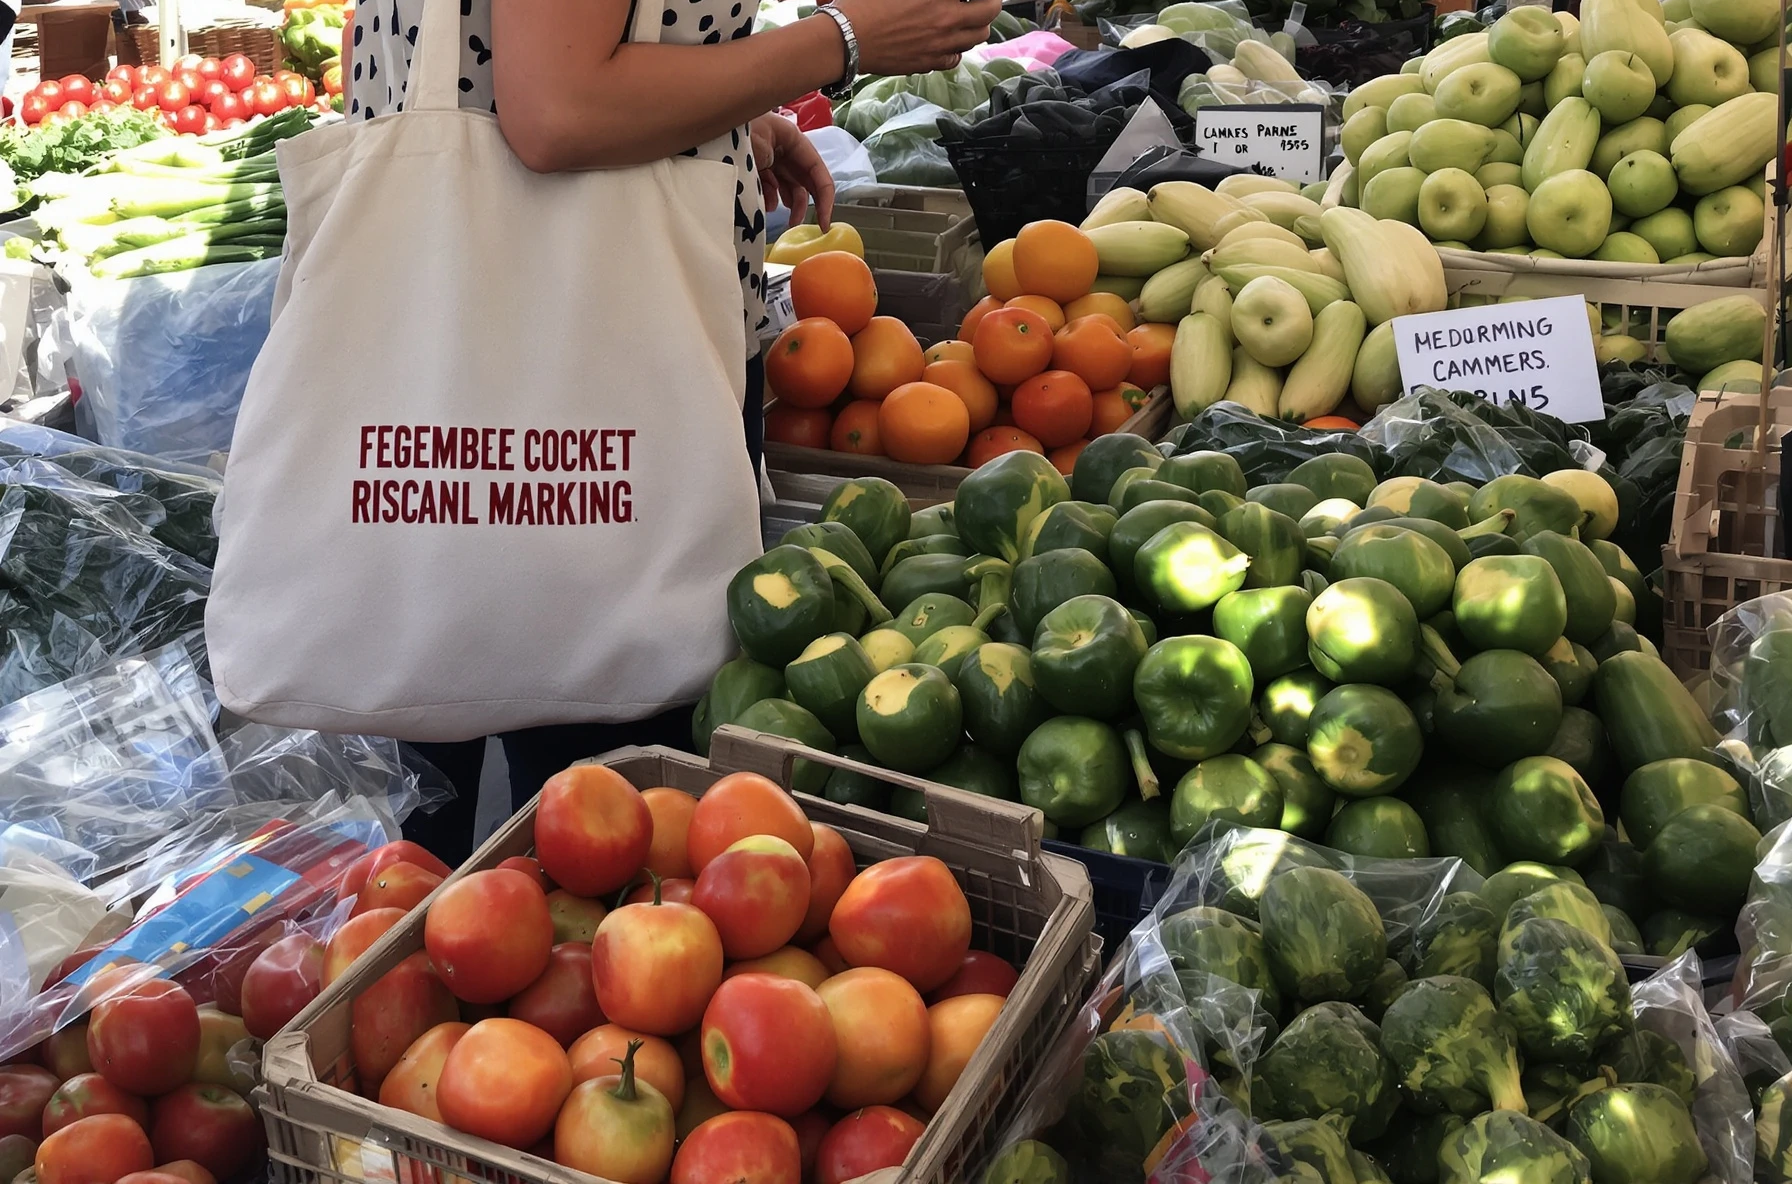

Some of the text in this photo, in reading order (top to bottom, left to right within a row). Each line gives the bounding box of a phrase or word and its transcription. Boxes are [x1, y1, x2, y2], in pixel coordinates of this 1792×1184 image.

[359, 425, 637, 472] FEGEMBEE COCKET
[352, 479, 479, 524] RISCANL
